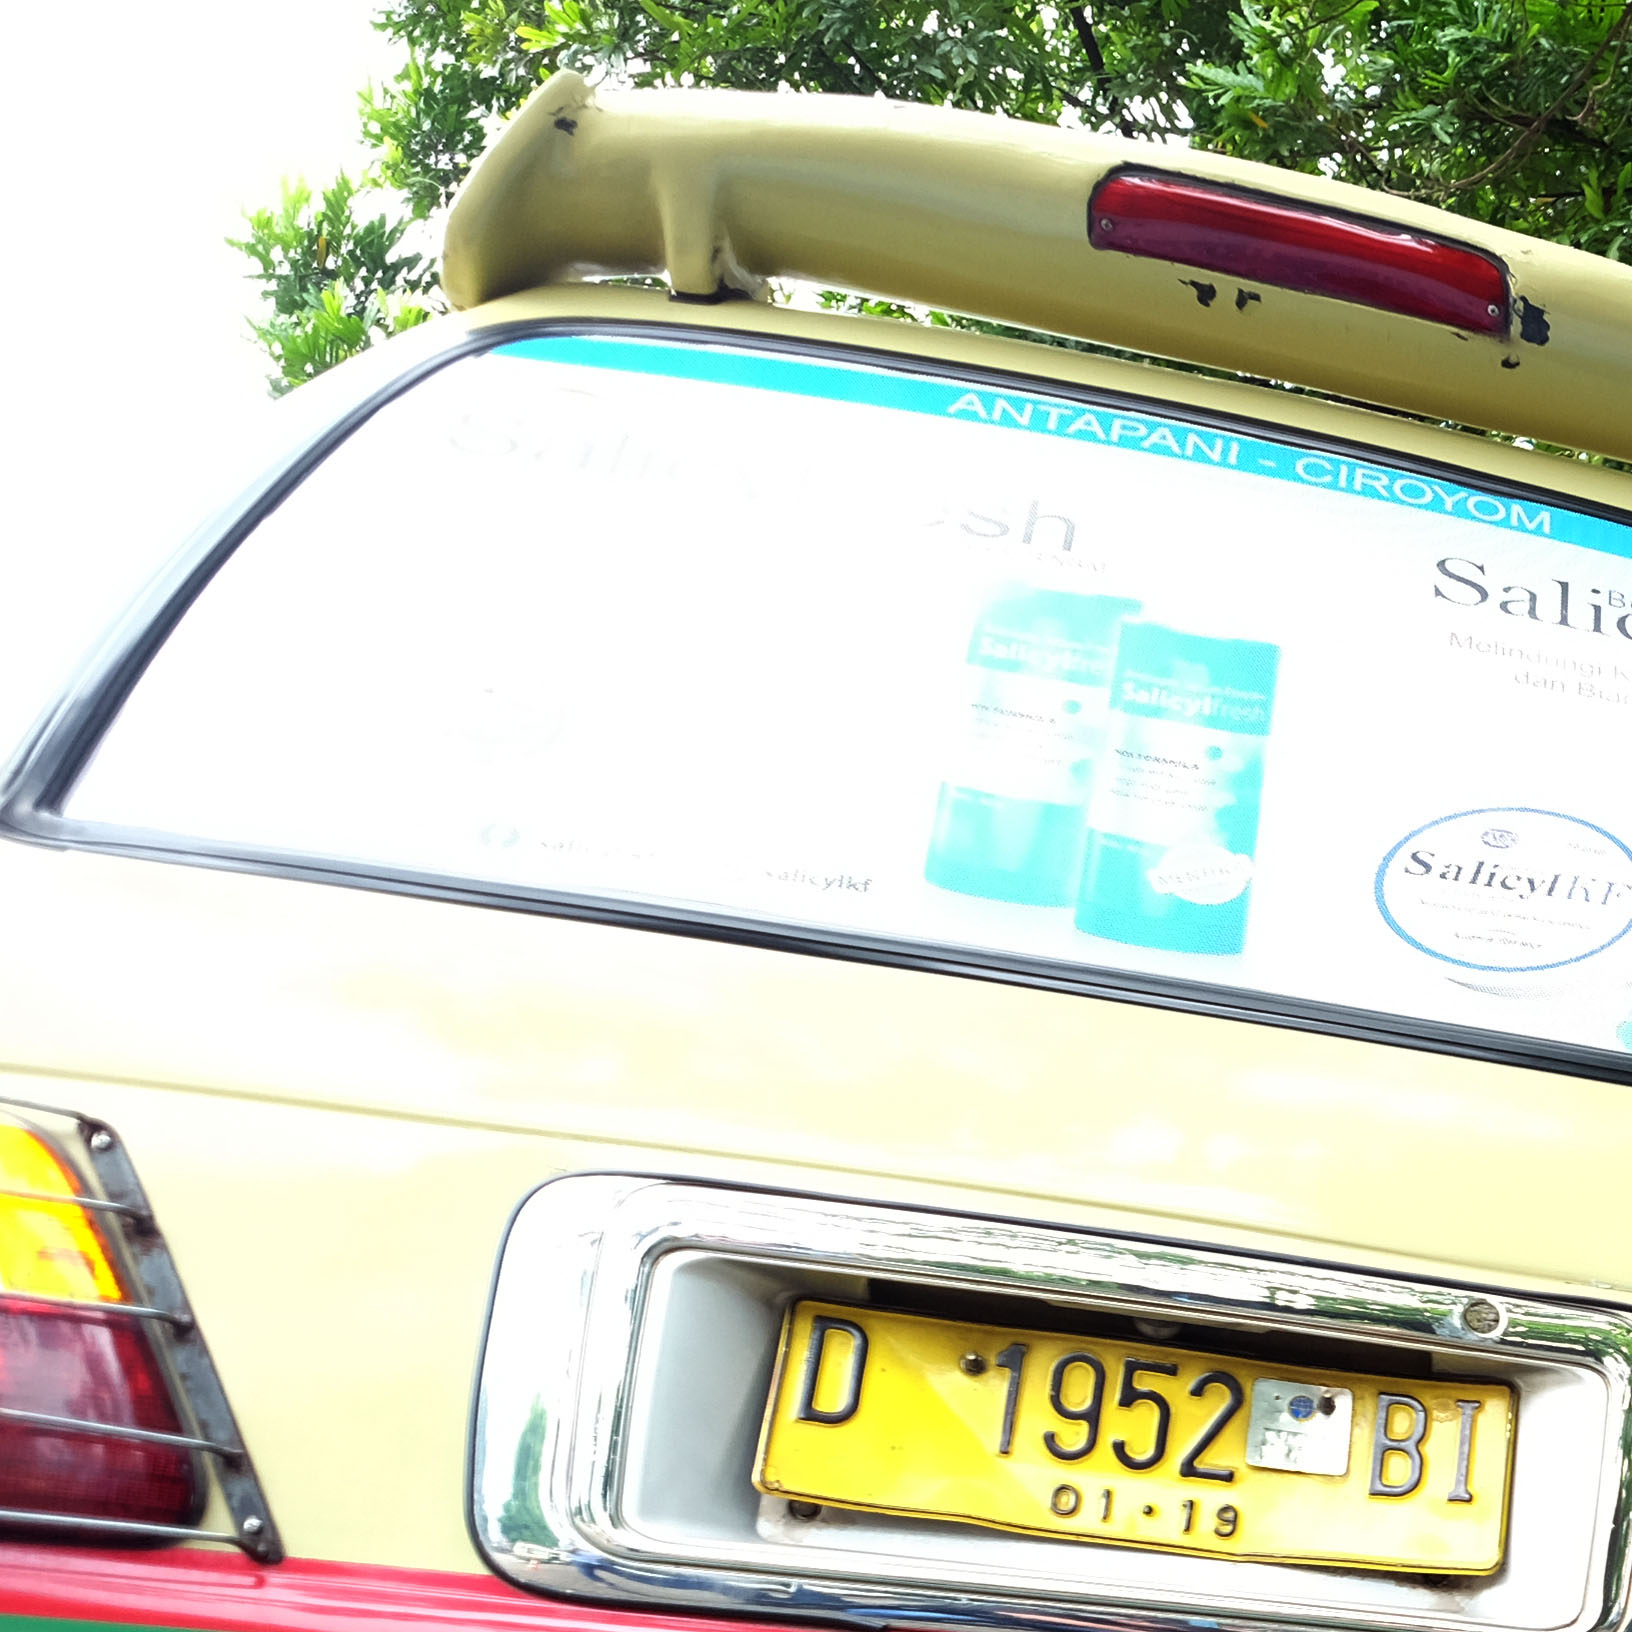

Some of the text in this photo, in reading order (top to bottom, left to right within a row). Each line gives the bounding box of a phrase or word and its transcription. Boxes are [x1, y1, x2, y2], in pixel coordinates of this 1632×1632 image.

[946, 389, 1242, 468] ANTAPANI
[1294, 456, 1554, 536] CIROYOM
[1511, 669, 1568, 694] dan
[796, 1315, 1483, 1503] D 1952 BI
